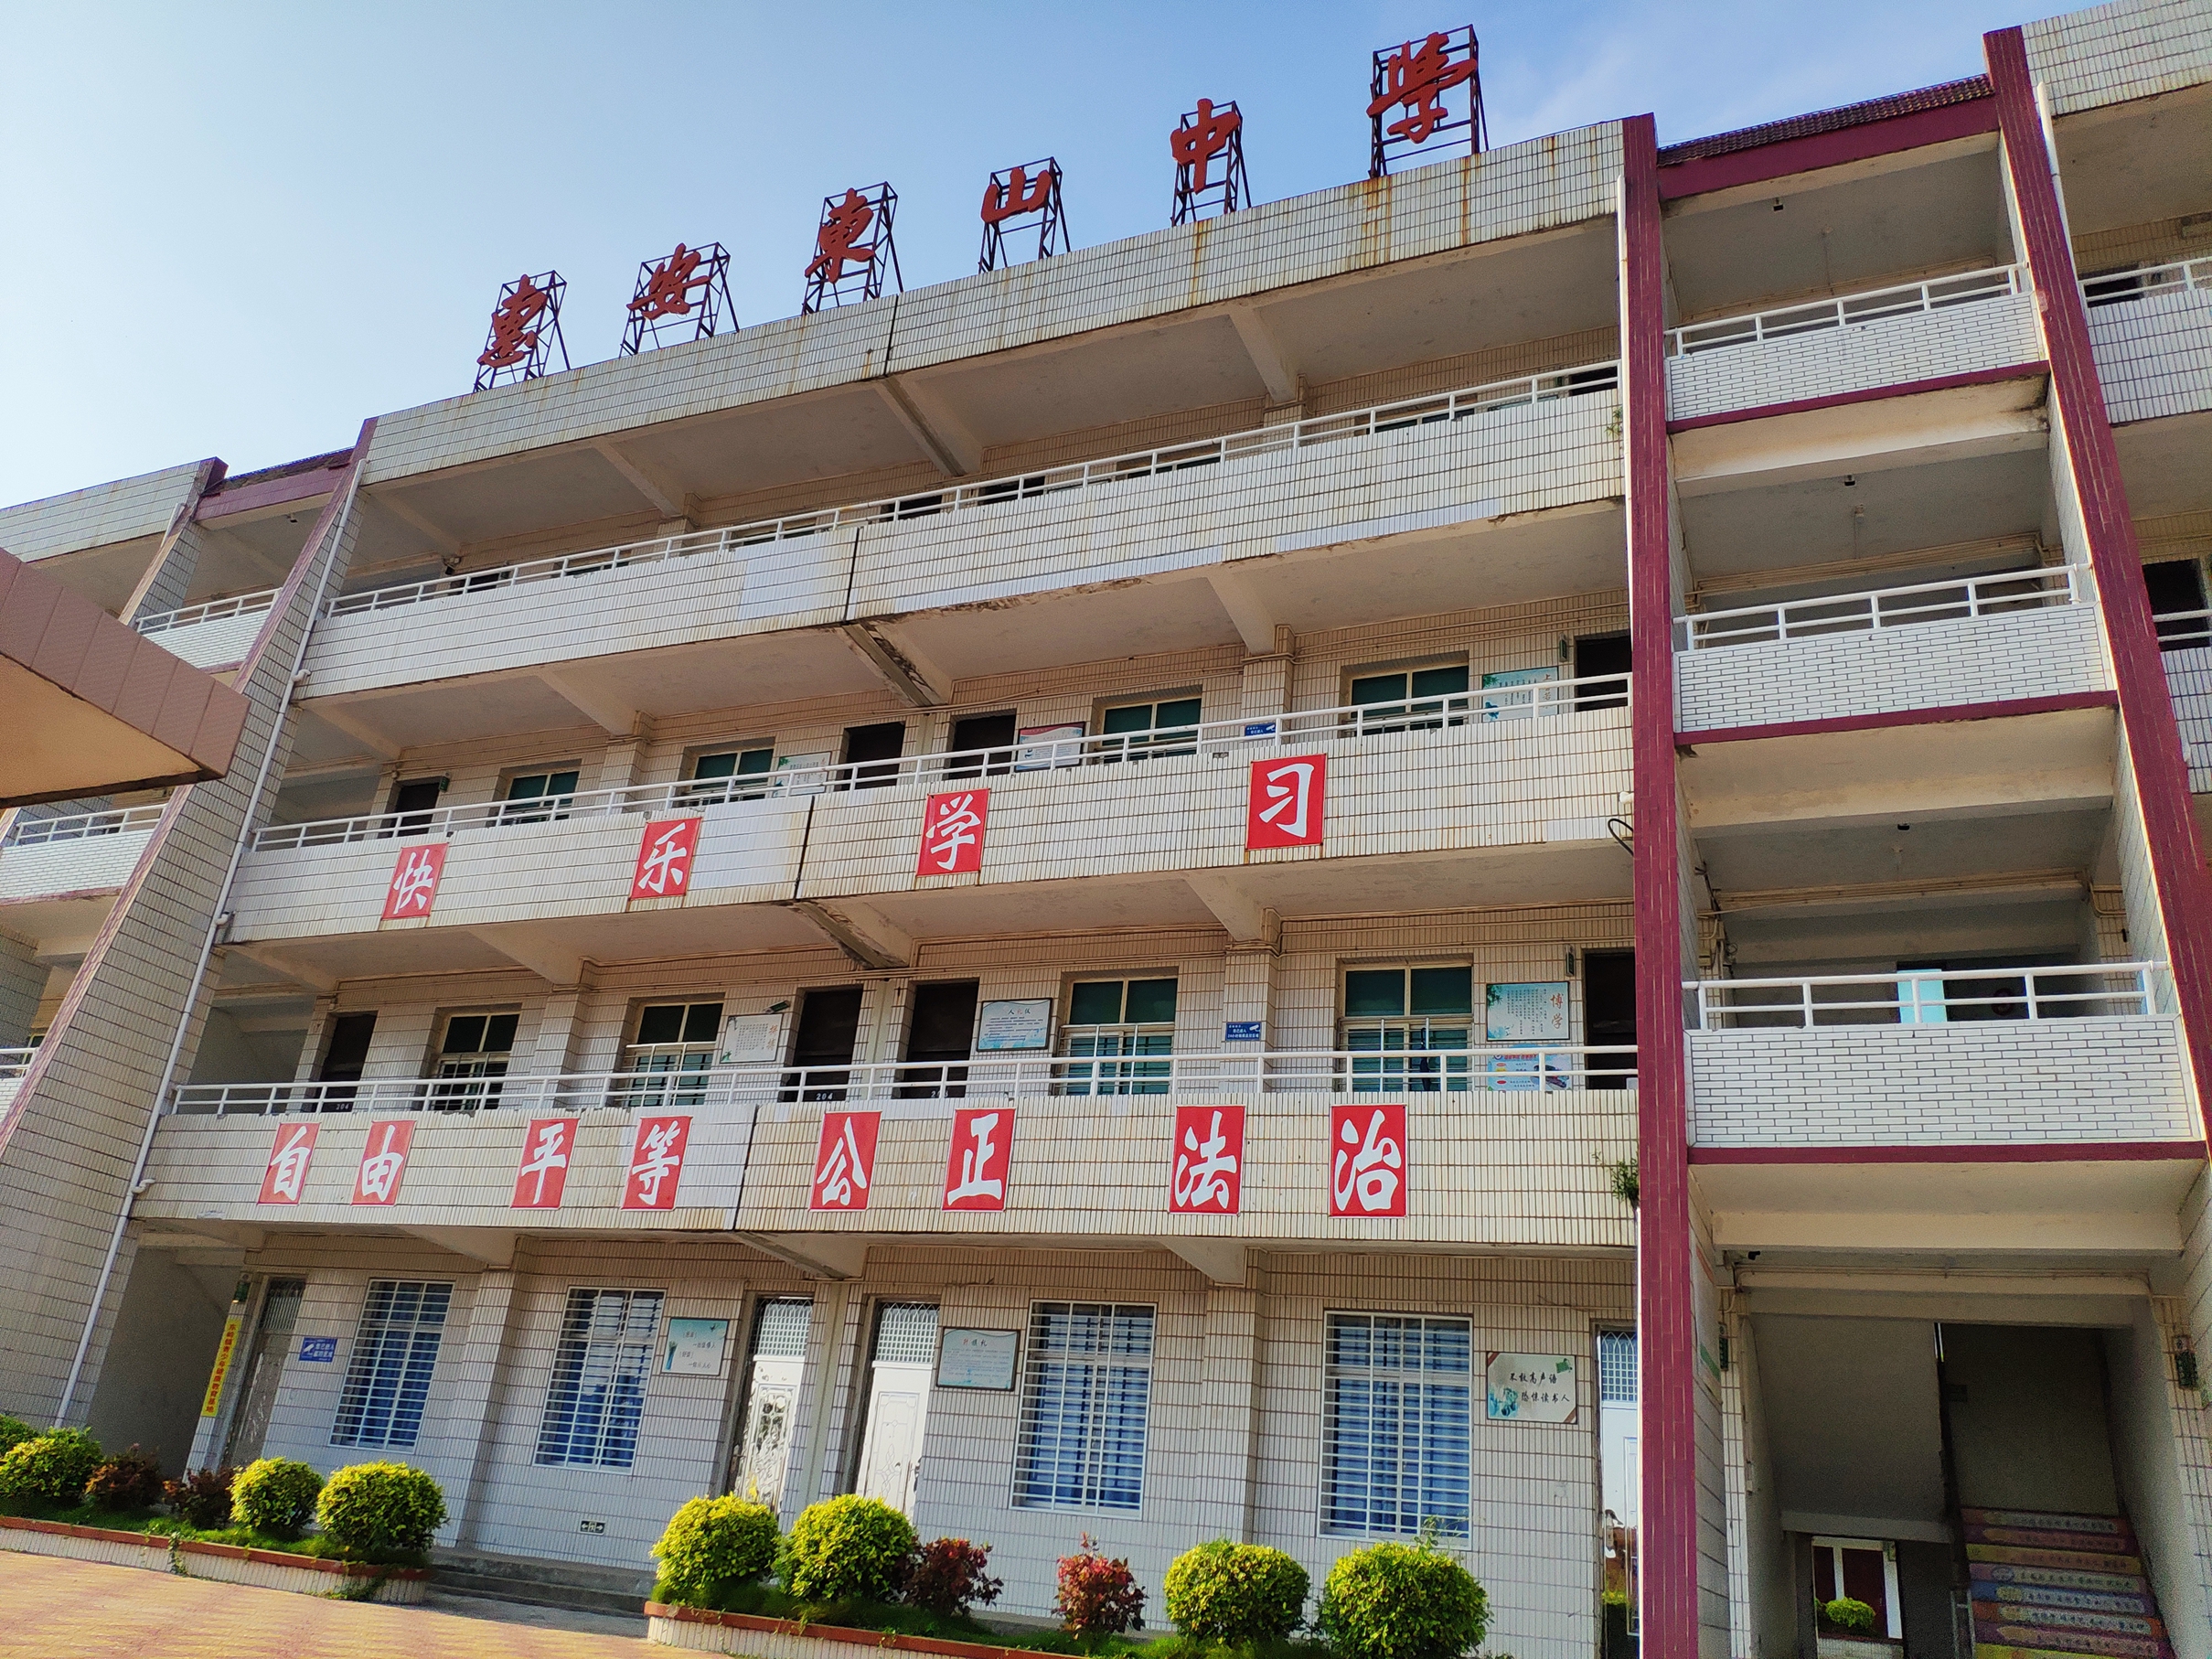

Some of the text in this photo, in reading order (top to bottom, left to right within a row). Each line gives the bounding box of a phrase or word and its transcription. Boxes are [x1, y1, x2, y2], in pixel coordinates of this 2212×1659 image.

[1550, 992, 1565, 1029] 博学
[816, 1093, 833, 1101] 204
[271, 1109, 1402, 1212] 自由 平等 公正 法治
[1509, 1371, 1557, 1386] 不敢高声语
[1522, 1391, 1570, 1403] 恐惊读书人
